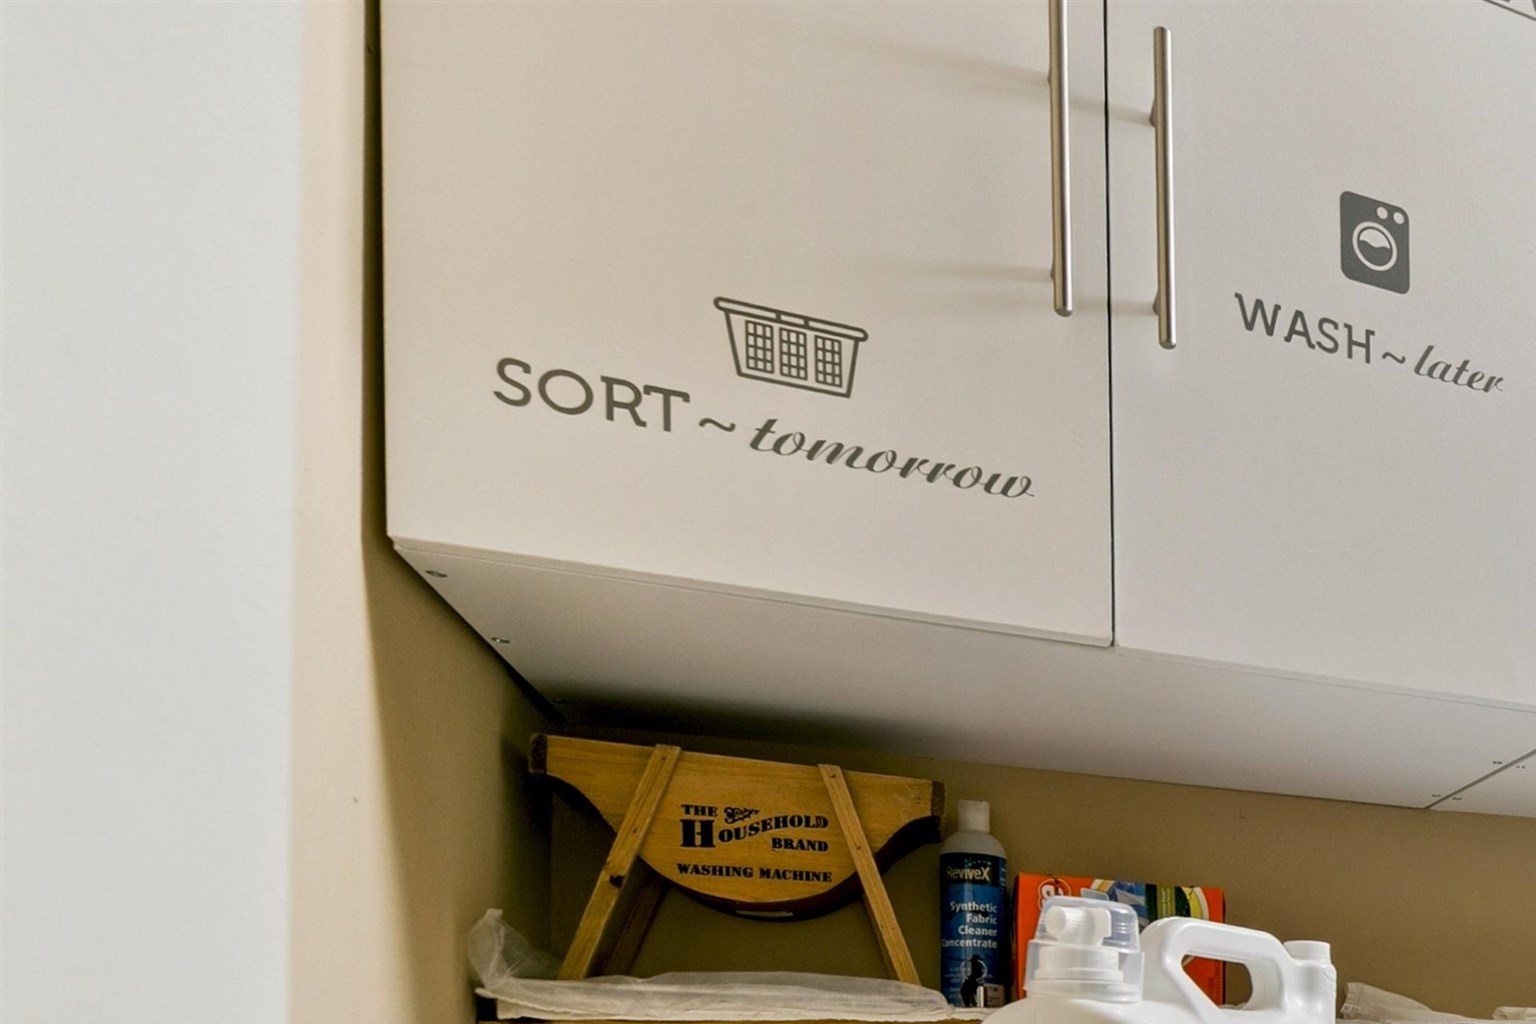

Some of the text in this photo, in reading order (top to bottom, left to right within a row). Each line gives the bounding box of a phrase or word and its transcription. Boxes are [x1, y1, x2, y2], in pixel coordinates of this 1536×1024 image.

[1234, 292, 1375, 364] WASH
[1413, 345, 1504, 393] later
[493, 357, 690, 433] SORT
[749, 418, 1036, 498] tomorrow
[681, 804, 718, 817] THE
[680, 814, 829, 849] HOUSEHOLD
[772, 837, 829, 852] BRAND
[677, 863, 832, 883] WASHING MACHINE
[946, 866, 990, 881] ReviveX
[950, 901, 998, 914] Synthetic
[966, 913, 998, 925] Fabric
[958, 925, 998, 937] Cleaner
[941, 938, 998, 949] Concentrate
